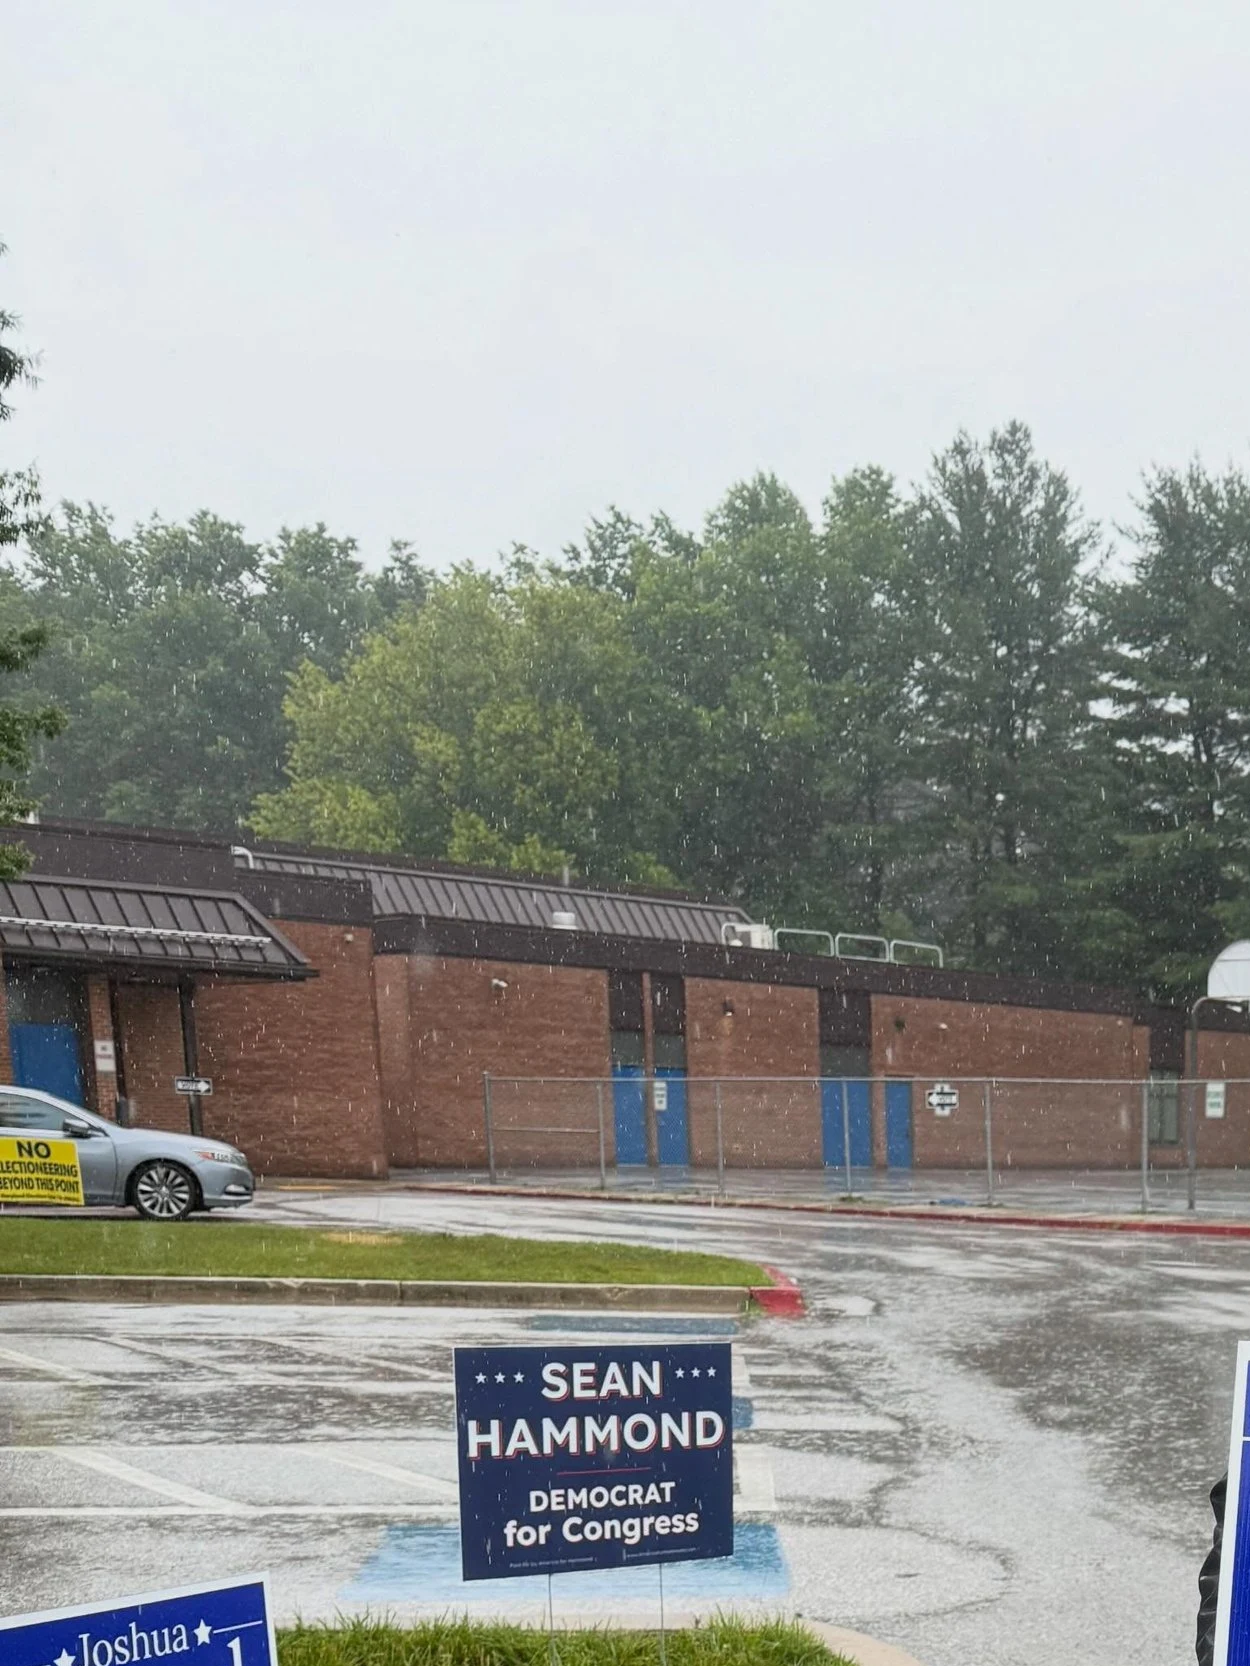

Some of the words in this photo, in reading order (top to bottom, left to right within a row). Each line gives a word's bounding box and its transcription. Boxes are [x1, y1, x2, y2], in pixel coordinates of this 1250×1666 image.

[16, 1140, 51, 1159] NO
[0, 1161, 78, 1178] LECTIONEERING
[36, 1178, 55, 1191] THIS
[56, 1180, 80, 1194] POINT
[541, 1360, 663, 1400] SEAN
[467, 1410, 725, 1461] HAMMOND
[529, 1481, 676, 1512] DEMOCRAT
[503, 1519, 552, 1547] for
[562, 1512, 699, 1545] Congress
